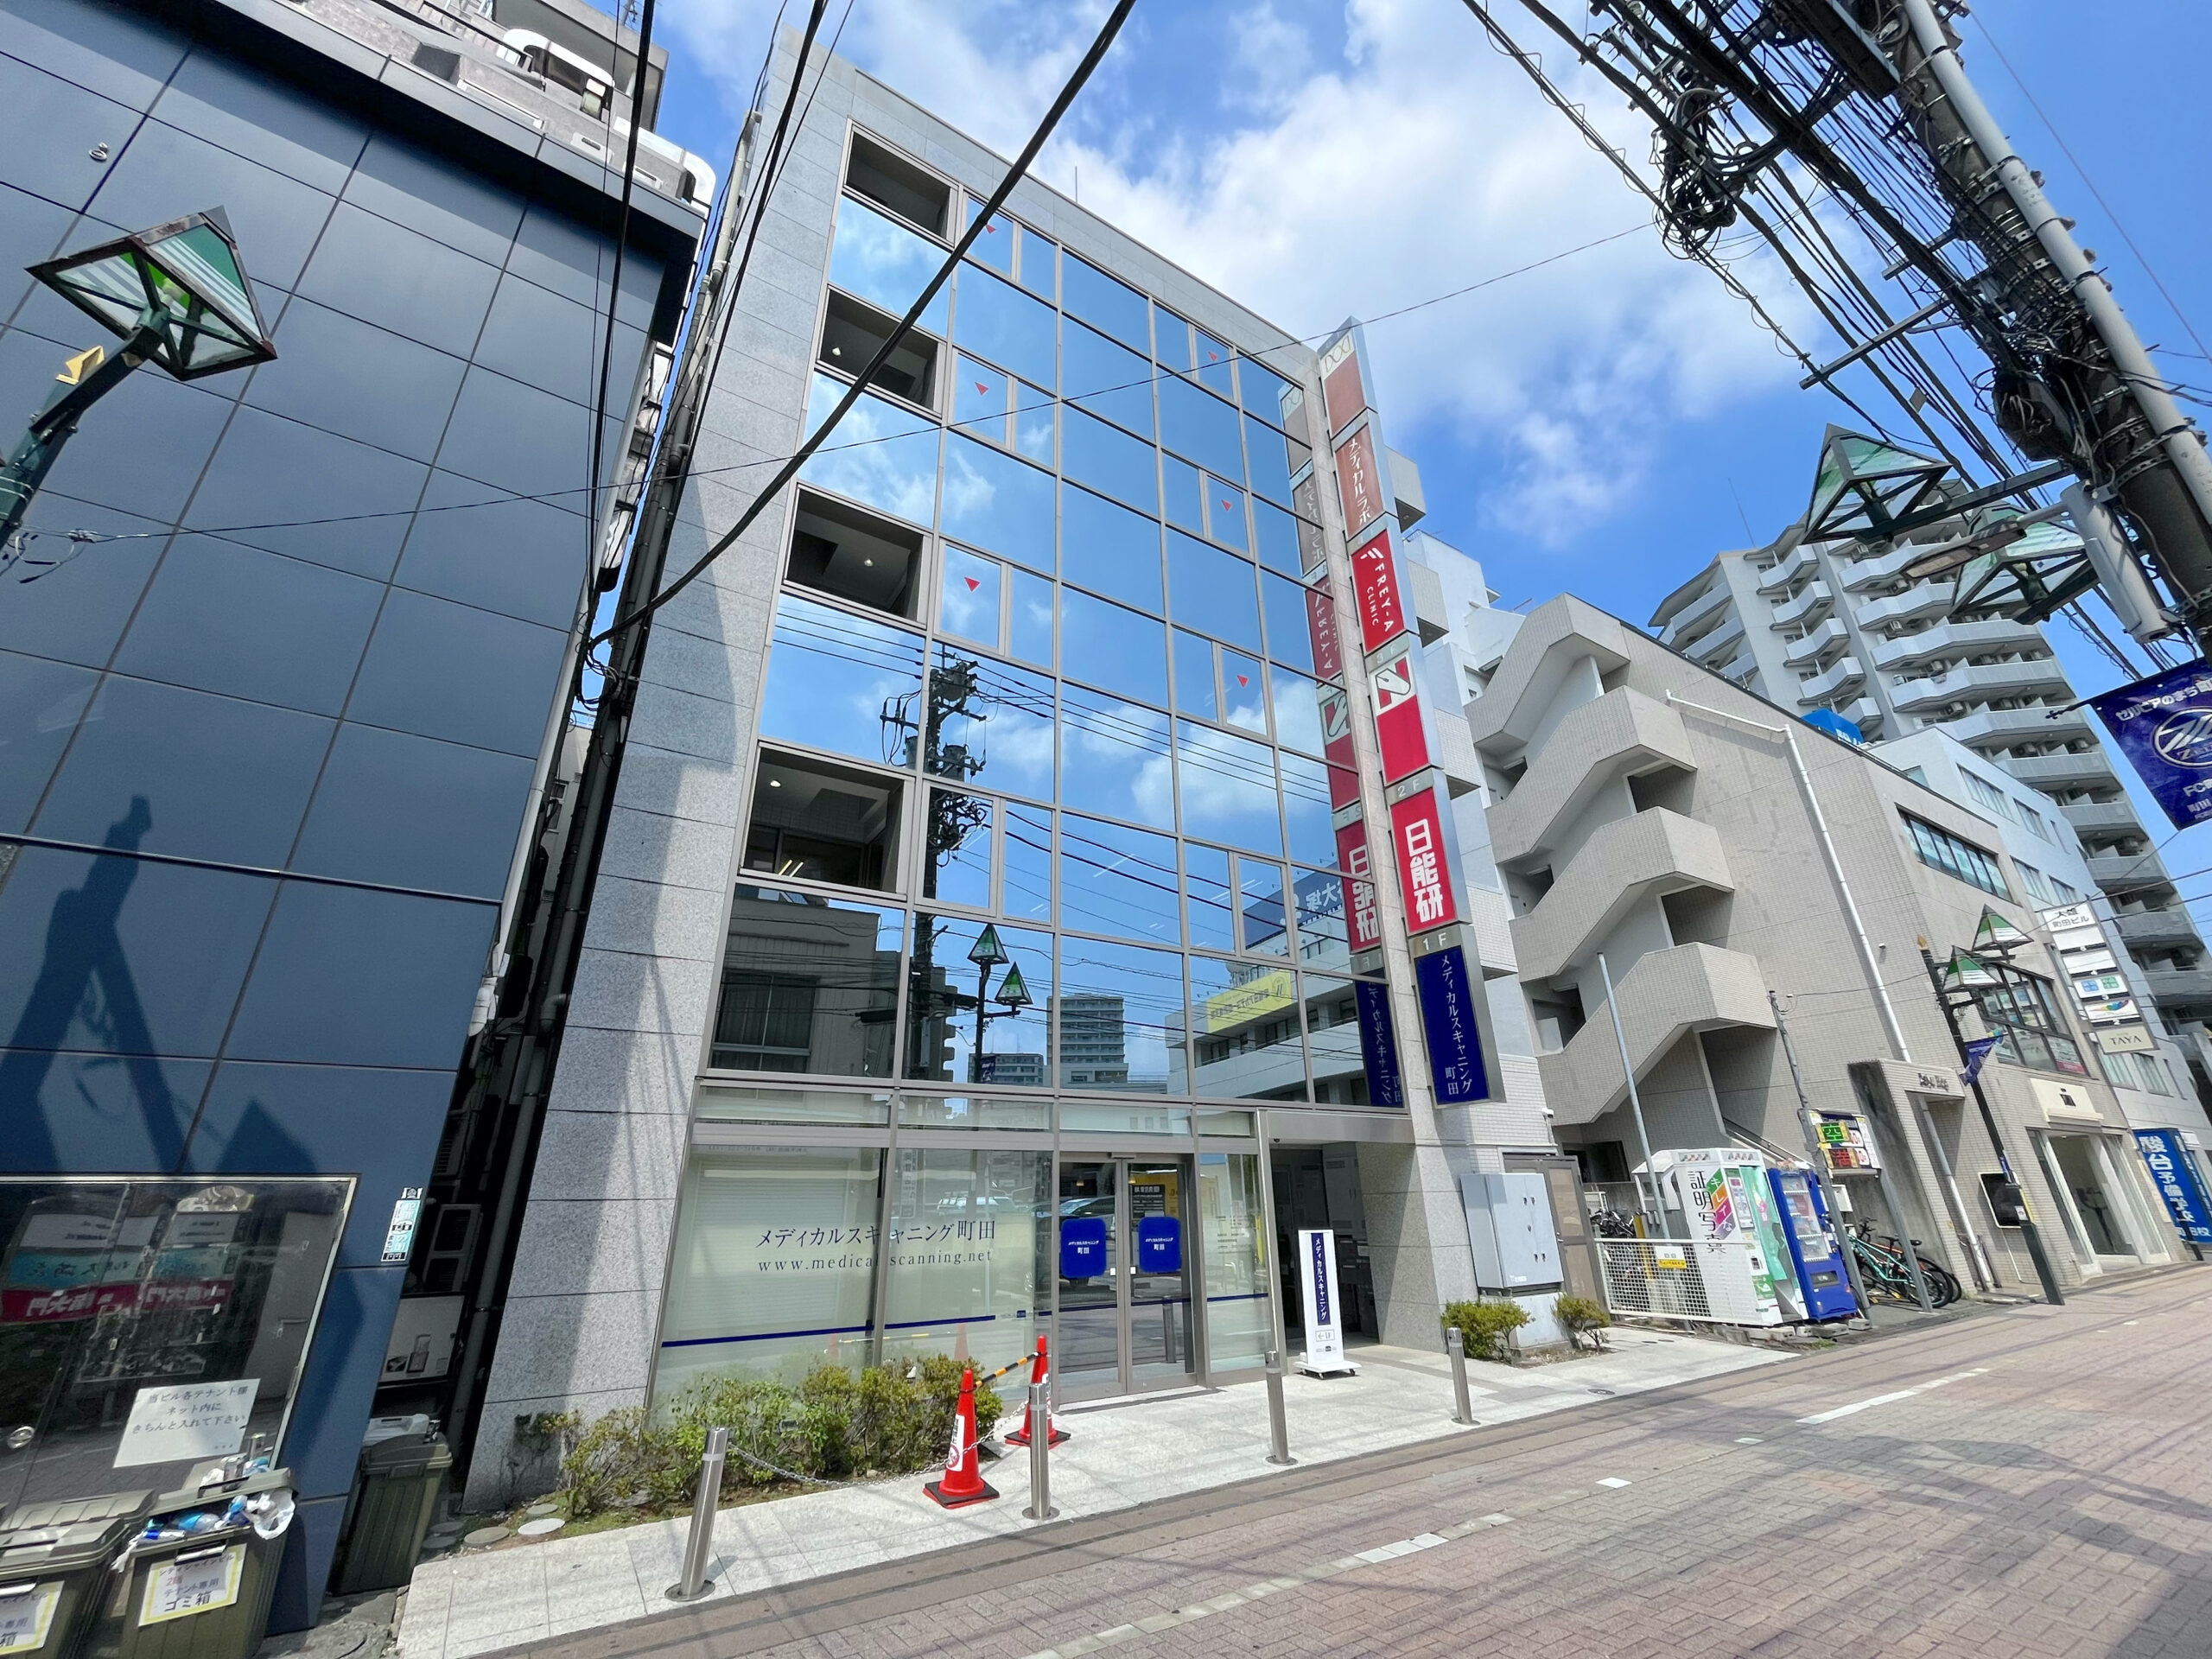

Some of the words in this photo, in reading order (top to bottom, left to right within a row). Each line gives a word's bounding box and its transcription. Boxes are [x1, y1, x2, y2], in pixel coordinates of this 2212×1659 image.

[1349, 437, 1372, 525] メディカルラボ
[1367, 587, 1379, 626] CLINIC
[1375, 563, 1395, 632] FREY-A
[1398, 780, 1420, 798] 2F
[1405, 818, 1444, 924] 日能研
[1423, 932, 1446, 950] 1F
[1440, 955, 1472, 1094] メディカルスキャニング
[2109, 1035, 2142, 1046] TAYA
[1445, 1066, 1459, 1095] 町田
[1688, 1171, 1726, 1253] 証明写真
[1315, 1237, 1327, 1320] メディカルスキャニング
[149, 1385, 248, 1402] 当ビル各テナント様
[166, 1402, 221, 1415] ネット内に
[133, 1414, 245, 1433] きちんと入れて下さい
[163, 1591, 213, 1611] ゴミ箱
